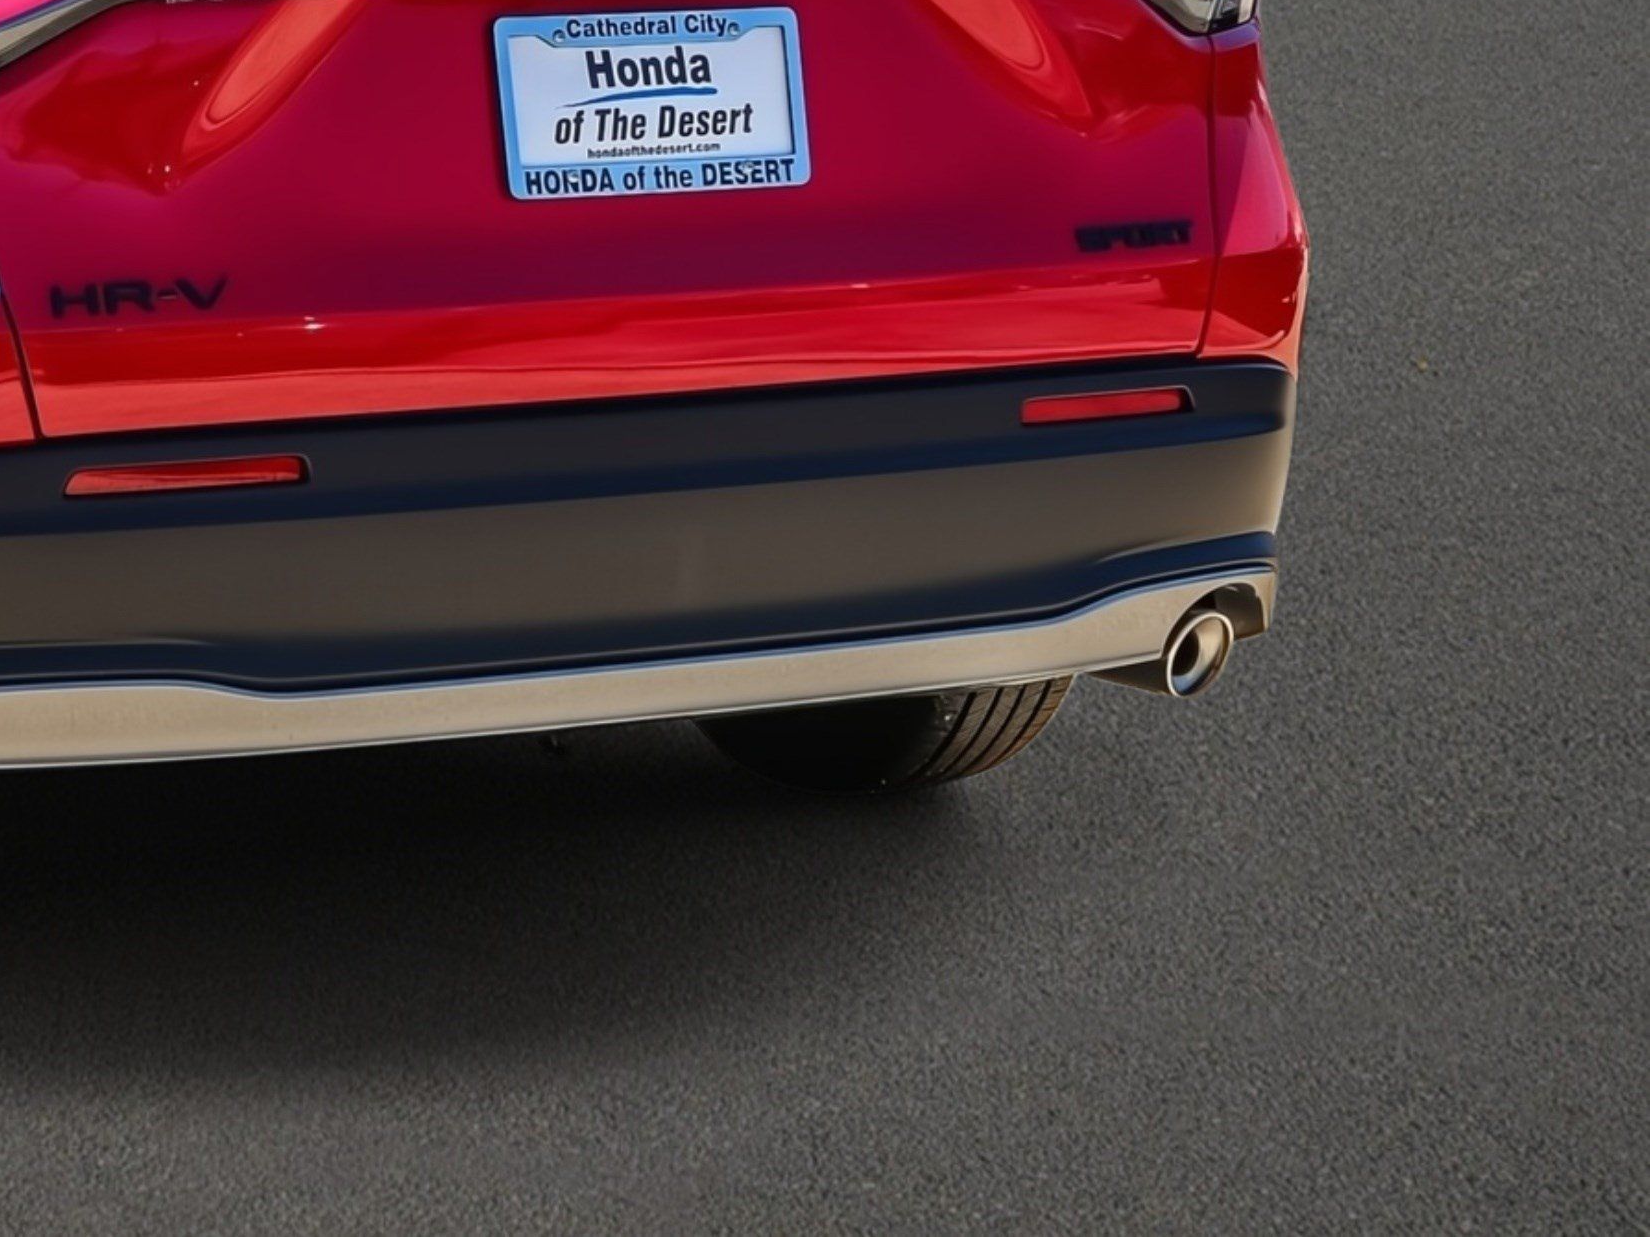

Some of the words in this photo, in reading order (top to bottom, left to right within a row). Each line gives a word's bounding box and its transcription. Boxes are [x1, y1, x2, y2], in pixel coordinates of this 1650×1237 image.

[565, 15, 676, 39] Cathedral
[684, 13, 728, 37] City
[585, 45, 712, 89] Honda
[554, 109, 585, 144] of
[594, 107, 647, 141] The
[657, 102, 754, 139] Desert
[586, 142, 721, 159] hondaofthedesert.com
[525, 167, 615, 195] HONDA
[623, 165, 651, 190] of
[653, 163, 693, 189] the
[702, 158, 796, 187] DESERT
[50, 274, 229, 319] HR-V
